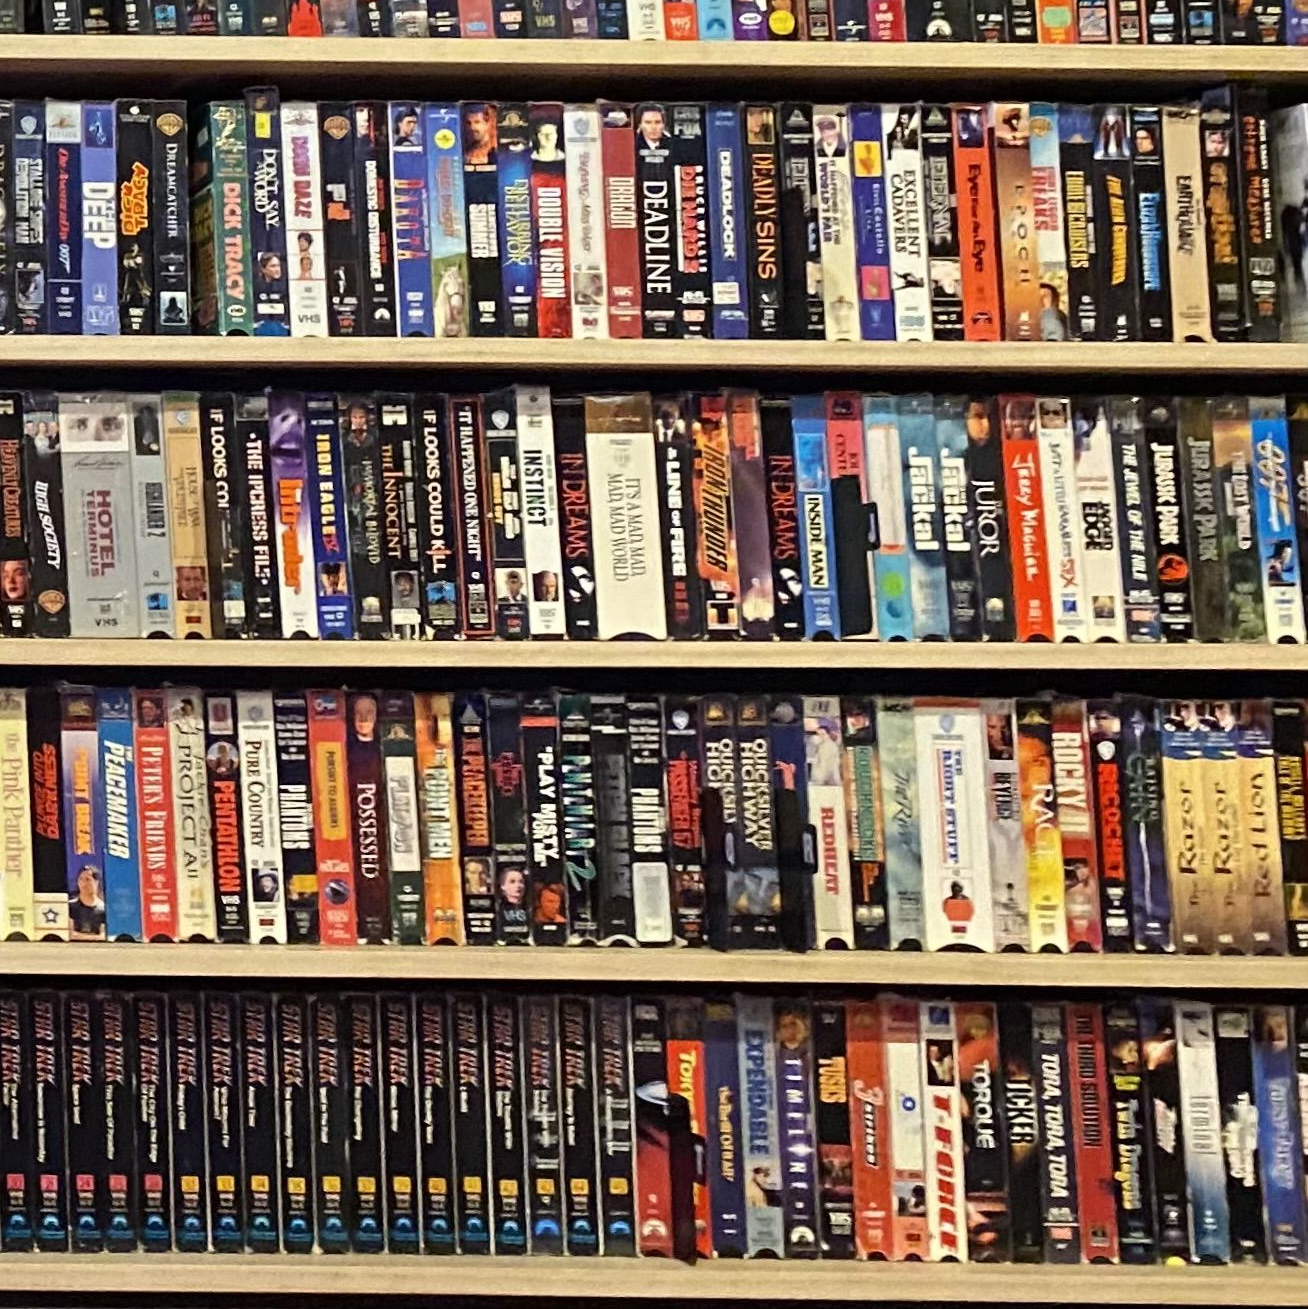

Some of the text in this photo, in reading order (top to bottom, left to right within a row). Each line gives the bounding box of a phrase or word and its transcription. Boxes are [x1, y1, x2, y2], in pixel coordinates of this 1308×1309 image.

[223, 183, 243, 299] DICK TRACY
[538, 187, 565, 298] DOUBLE VISION
[644, 181, 671, 293] DEADLINE
[720, 151, 734, 258] DEADLOCK
[753, 153, 776, 279] DEADLY SINS
[891, 174, 906, 253] CADAVERS
[905, 169, 920, 258] EXCELLENT
[246, 440, 262, 469] THE
[524, 450, 545, 527] INSTINCT
[908, 447, 939, 550] Jackal
[1151, 443, 1178, 545] JURASSIC PARK
[86, 490, 98, 576] TERMINUS
[96, 490, 115, 577] HOTEL
[248, 475, 267, 541] IPCRESS
[807, 497, 825, 585] INSIDE MAN
[141, 747, 166, 869] PETER'S FRIENDS
[245, 740, 266, 848] PURE COUNTRY
[740, 741, 759, 849] HIGHWAY
[753, 738, 772, 850] QUICKSILVER
[1052, 732, 1086, 809] ROCKY
[214, 781, 240, 891] PENTATHLON
[357, 783, 378, 878] POSSESSED
[140, 1046, 160, 1086] TREK
[818, 1057, 846, 1103] TUSKS
[973, 1060, 994, 1148] TORQUE
[1006, 1079, 1035, 1145] TICKER
[1041, 1054, 1068, 1197] TORA, TORA, TORA
